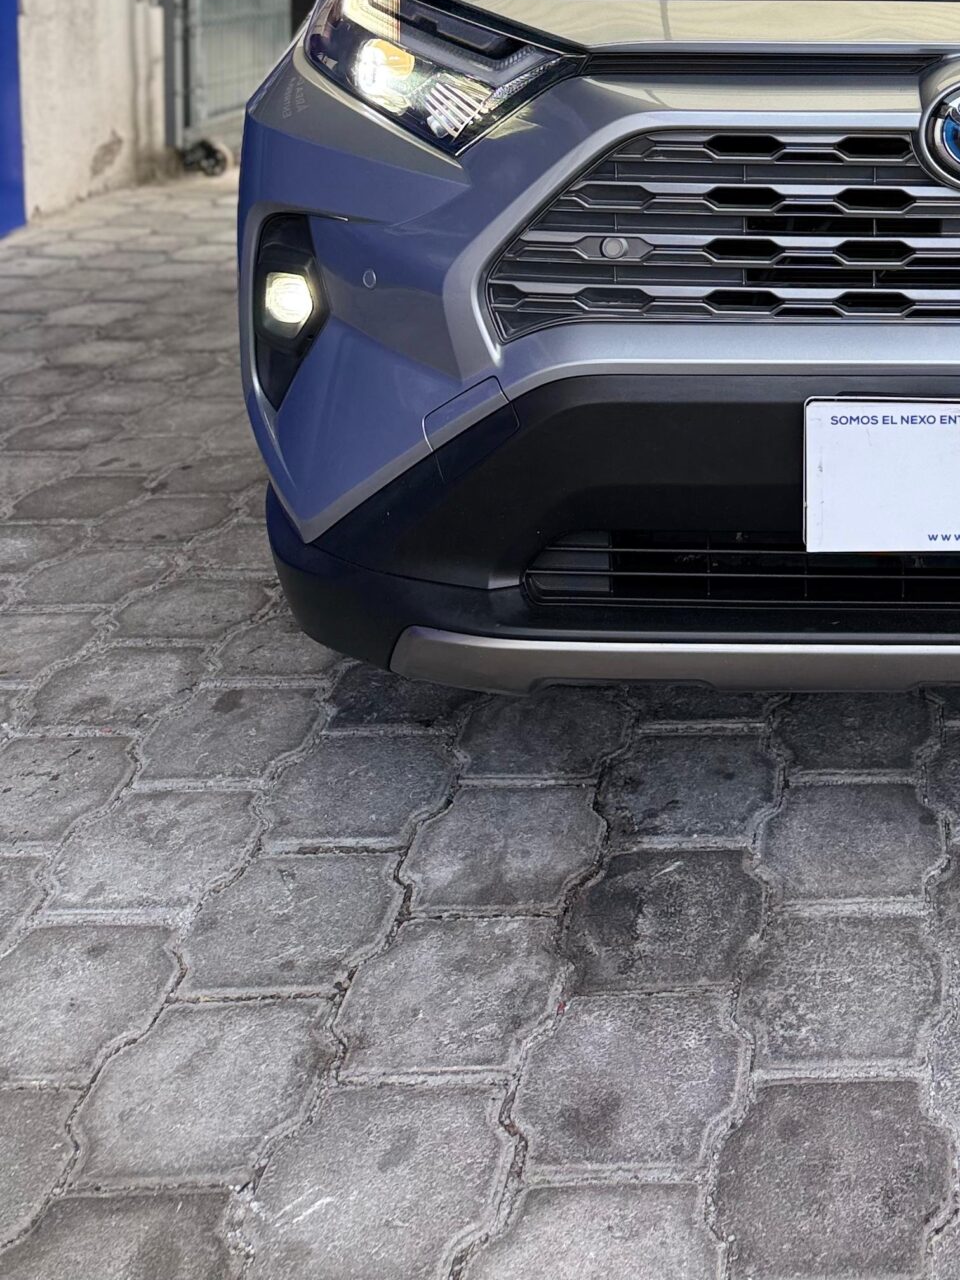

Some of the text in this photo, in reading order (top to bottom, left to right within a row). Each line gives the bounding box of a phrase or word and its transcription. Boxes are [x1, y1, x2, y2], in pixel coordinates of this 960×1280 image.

[830, 415, 879, 426] SOMOS
[881, 415, 898, 425] EL
[900, 414, 937, 425] NEXO
